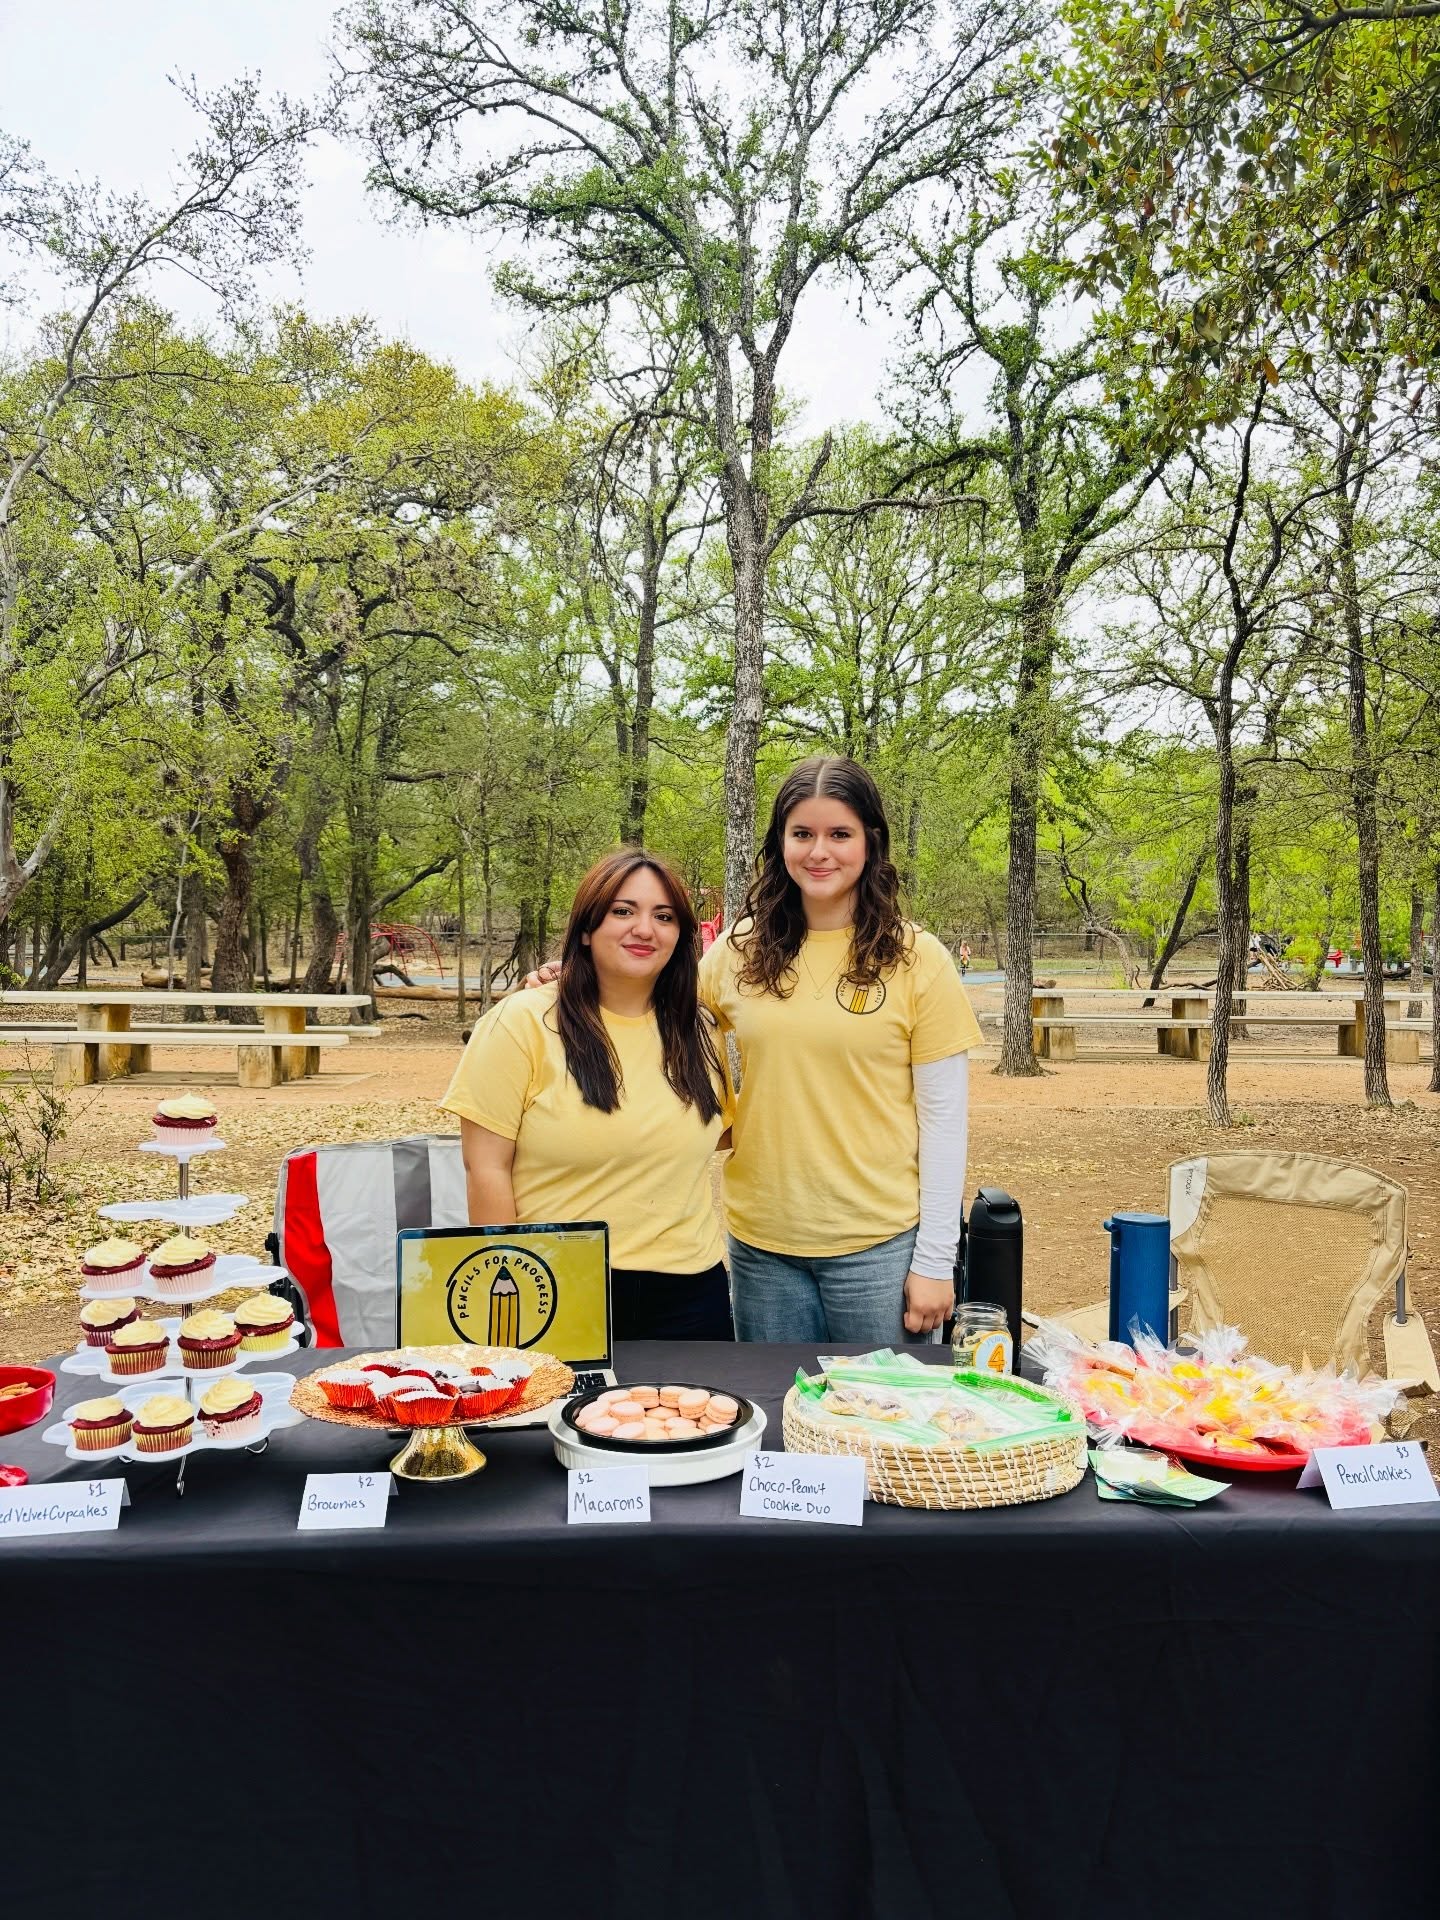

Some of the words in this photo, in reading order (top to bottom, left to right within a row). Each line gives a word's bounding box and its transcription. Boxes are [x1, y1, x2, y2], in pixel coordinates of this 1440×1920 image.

[457, 1267, 481, 1318] PENCILS
[484, 1255, 508, 1269] FOR
[513, 1257, 549, 1314] PROGRESS
[987, 1343, 1006, 1373] 4
[1395, 1445, 1410, 1459] $3
[754, 1454, 775, 1469] $2
[358, 1475, 374, 1488] $2
[577, 1472, 594, 1485] $2
[749, 1476, 827, 1496] Choco-Peanut
[88, 1481, 107, 1497] $1
[307, 1493, 366, 1511] Brownies
[574, 1491, 644, 1515] Macarons
[763, 1497, 802, 1512] Cookie
[806, 1502, 831, 1515] Duo
[0, 1507, 13, 1524] ed
